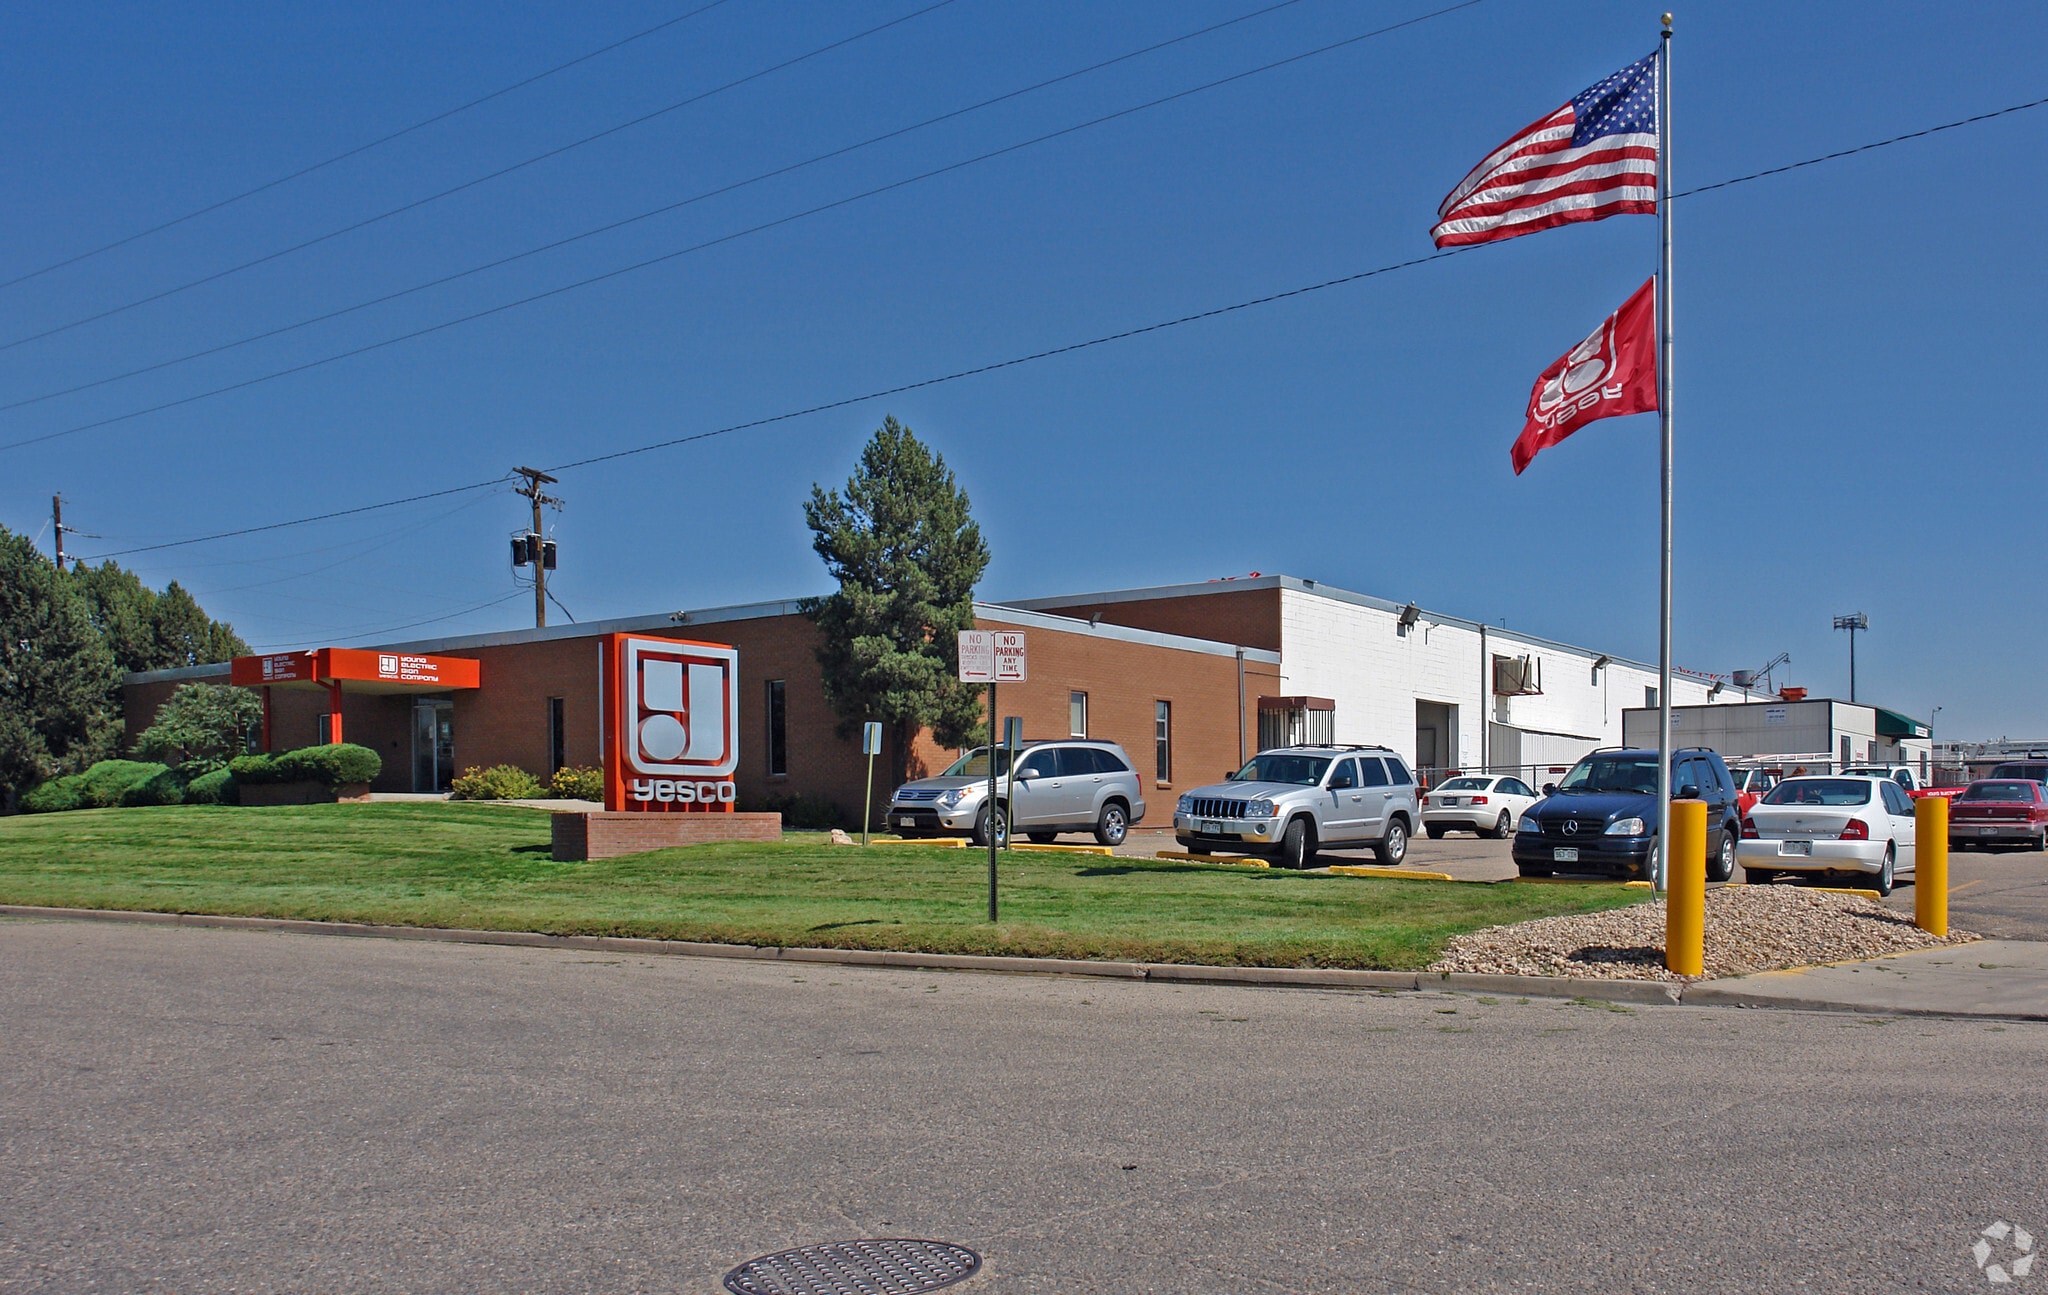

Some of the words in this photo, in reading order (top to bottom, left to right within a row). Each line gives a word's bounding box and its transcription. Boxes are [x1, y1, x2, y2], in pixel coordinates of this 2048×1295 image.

[969, 634, 982, 644] NO
[1003, 636, 1016, 645] NO
[961, 645, 989, 654] PARKING
[996, 647, 1024, 657] PARKING
[1002, 664, 1018, 672] TIME
[632, 778, 736, 804] yesco
